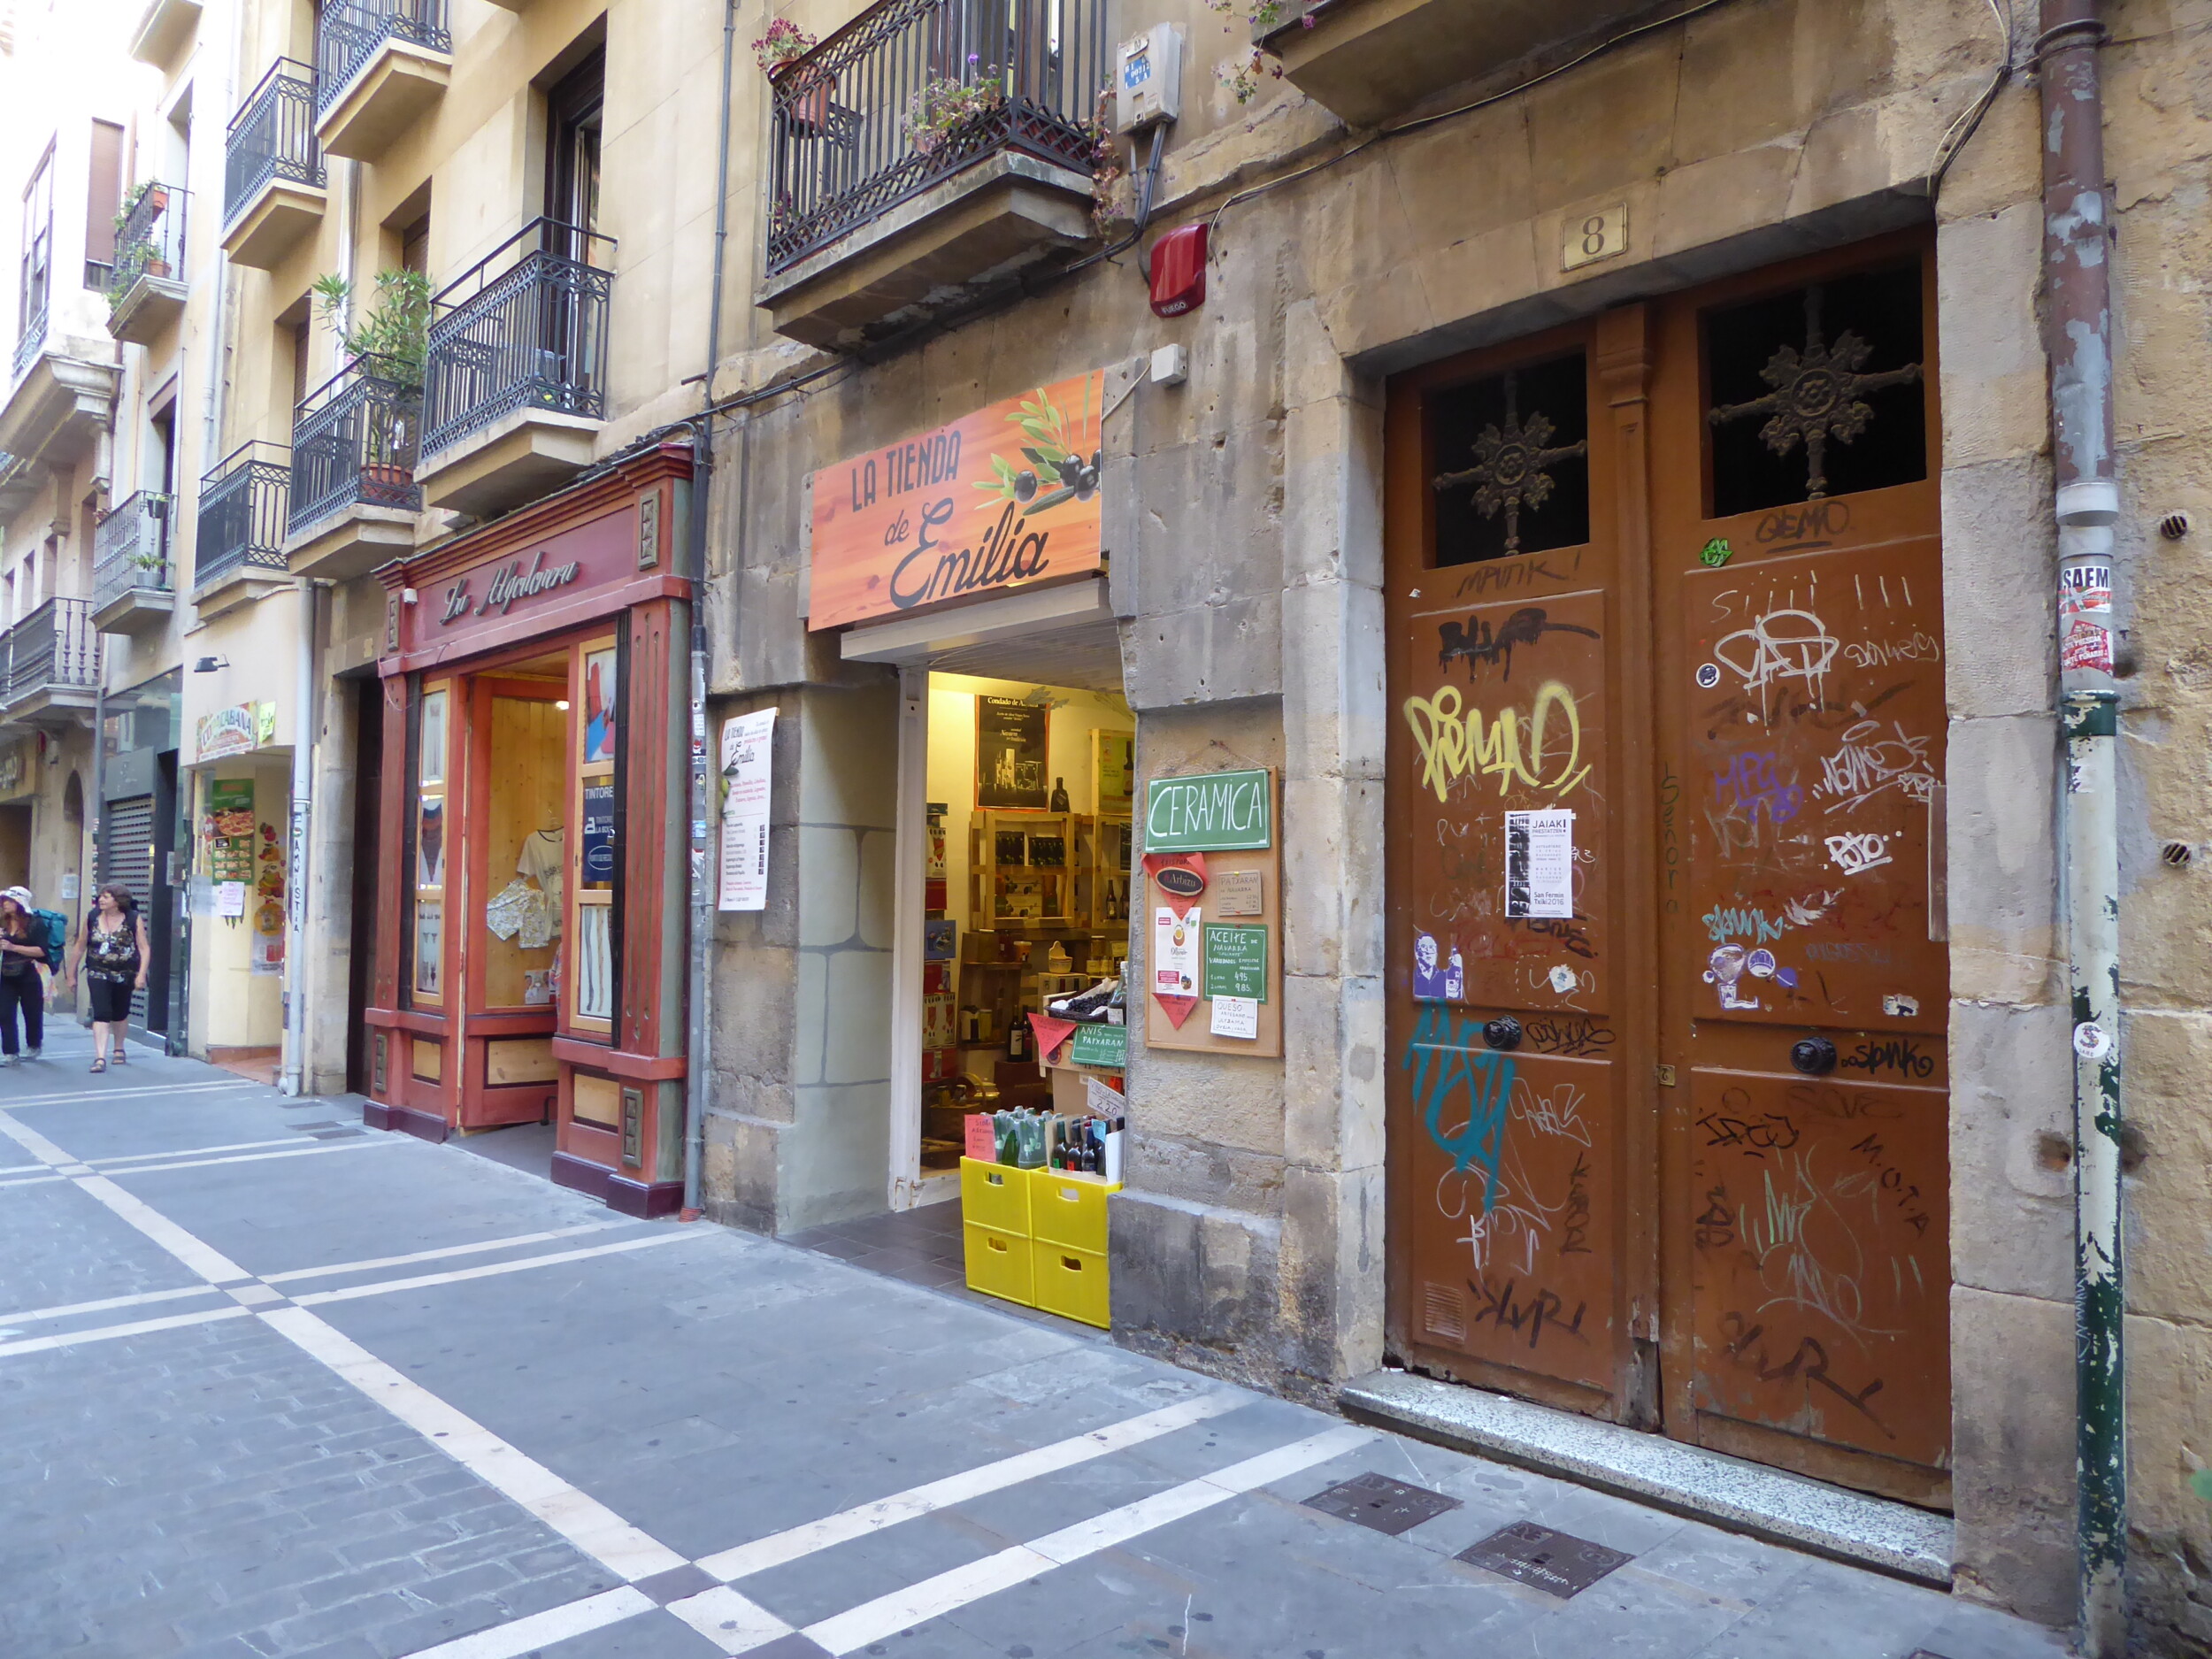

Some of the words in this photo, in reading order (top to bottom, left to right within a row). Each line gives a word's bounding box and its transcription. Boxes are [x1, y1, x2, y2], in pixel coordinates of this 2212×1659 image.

[1582, 216, 1605, 256] 8
[1161, 301, 1187, 314] FUEGO
[851, 458, 877, 513] LA
[886, 429, 962, 498] TIENDA
[884, 509, 910, 547] de
[889, 496, 1049, 610] Emilia
[439, 578, 471, 626] La
[585, 786, 613, 800] TINTORE
[1217, 1002, 1243, 1012] QUESO
